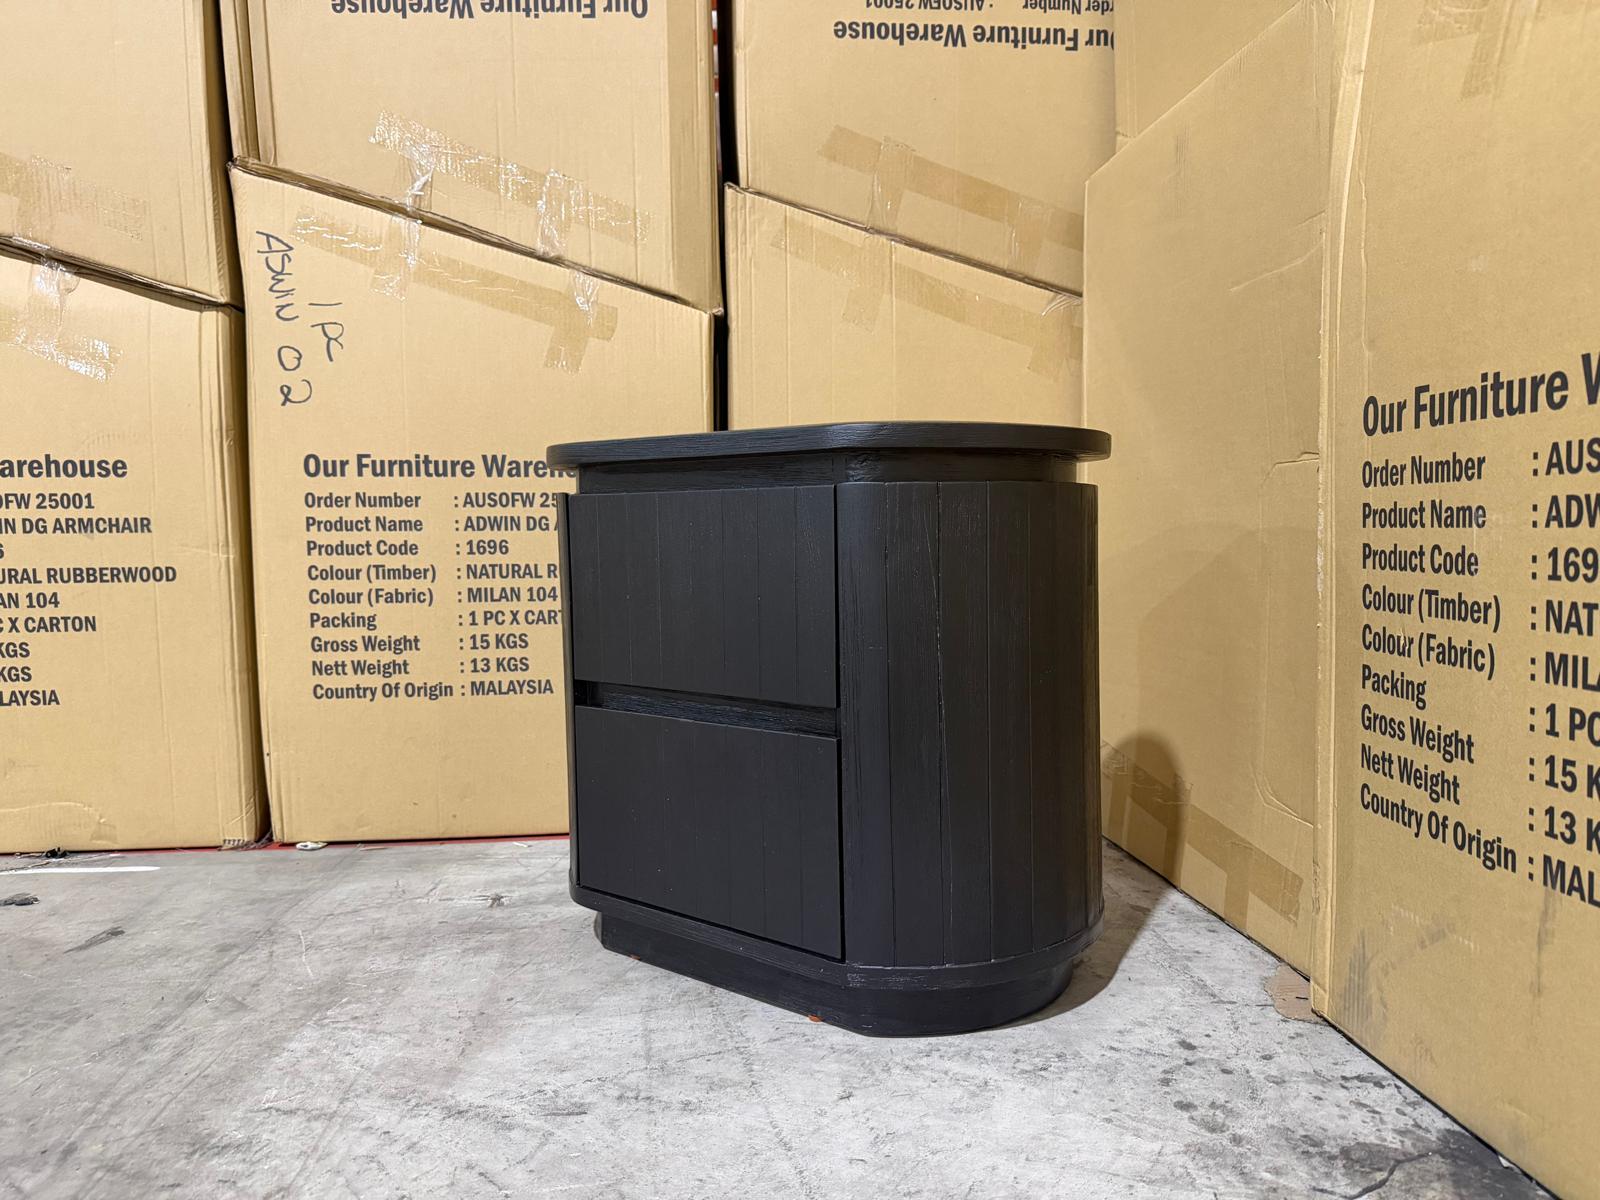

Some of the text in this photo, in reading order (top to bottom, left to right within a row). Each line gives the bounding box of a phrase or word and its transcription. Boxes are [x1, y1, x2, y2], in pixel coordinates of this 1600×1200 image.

[332, 0, 647, 19] Our Furniture Warehouse
[834, 21, 966, 47] Warehouse
[973, 25, 1078, 51] Furniture
[1363, 396, 1407, 436] Our
[1414, 371, 1568, 429] Furniture
[304, 454, 349, 477] Our
[357, 454, 475, 477] Furniture
[1362, 459, 1406, 488] Order
[1411, 452, 1485, 484] Number
[36, 493, 94, 509] 25001
[305, 492, 351, 508] Order
[356, 492, 421, 507] Number
[463, 492, 535, 508] AUSOFW
[306, 516, 371, 532] Product
[376, 516, 423, 531] Name
[464, 516, 520, 531] ADWIN
[526, 516, 549, 531] DG
[1362, 501, 1425, 528] Product
[1431, 499, 1486, 528] Name
[22, 518, 47, 534] DG
[52, 517, 152, 534] ARMCHAIR
[307, 540, 372, 556] Product
[377, 540, 418, 555] Code
[467, 540, 509, 555] 1696
[1363, 543, 1425, 573] Product
[1430, 544, 1478, 576] Code
[47, 566, 176, 584] RUBBERWOOD
[308, 565, 362, 580] Colour
[367, 564, 436, 583] (Timber)
[467, 564, 543, 579] NATURAL
[26, 592, 60, 608] 104
[309, 589, 363, 604] Colour
[368, 588, 433, 607] (Fabric)
[468, 587, 520, 602] MILAN
[527, 586, 558, 603] 104
[310, 612, 377, 631] Packing
[469, 611, 478, 626] 1
[484, 610, 505, 625] PC
[510, 610, 520, 625] X
[1362, 584, 1414, 615] Colour
[1418, 589, 1500, 634] (Timber)
[1546, 600, 1599, 636] NAT
[8, 616, 21, 634] X
[24, 616, 96, 633] CARTON
[311, 636, 358, 652] Gross
[362, 635, 420, 655] Weight
[470, 634, 490, 650] 15
[495, 633, 528, 649] KGS
[1362, 624, 1414, 658] Colour
[1418, 631, 1496, 680] (Fabric)
[312, 661, 347, 676] Nett
[351, 660, 409, 678] Weight
[471, 658, 490, 673] 13
[496, 657, 529, 672] KGS
[313, 684, 377, 702] Country
[382, 682, 400, 698] Of
[404, 682, 453, 700] Origin
[471, 679, 553, 696] MALAYSIA
[1361, 662, 1426, 712] Packing
[1546, 703, 1559, 738] 1
[1361, 704, 1405, 741] Gross
[1410, 716, 1474, 766] Weight
[1545, 755, 1577, 793] 15
[1361, 743, 1394, 780] Nett
[1397, 754, 1462, 806] Weight
[1545, 806, 1576, 844] 13
[1361, 782, 1423, 838] Country
[1428, 811, 1448, 844] Of
[1453, 821, 1516, 873] Origin
